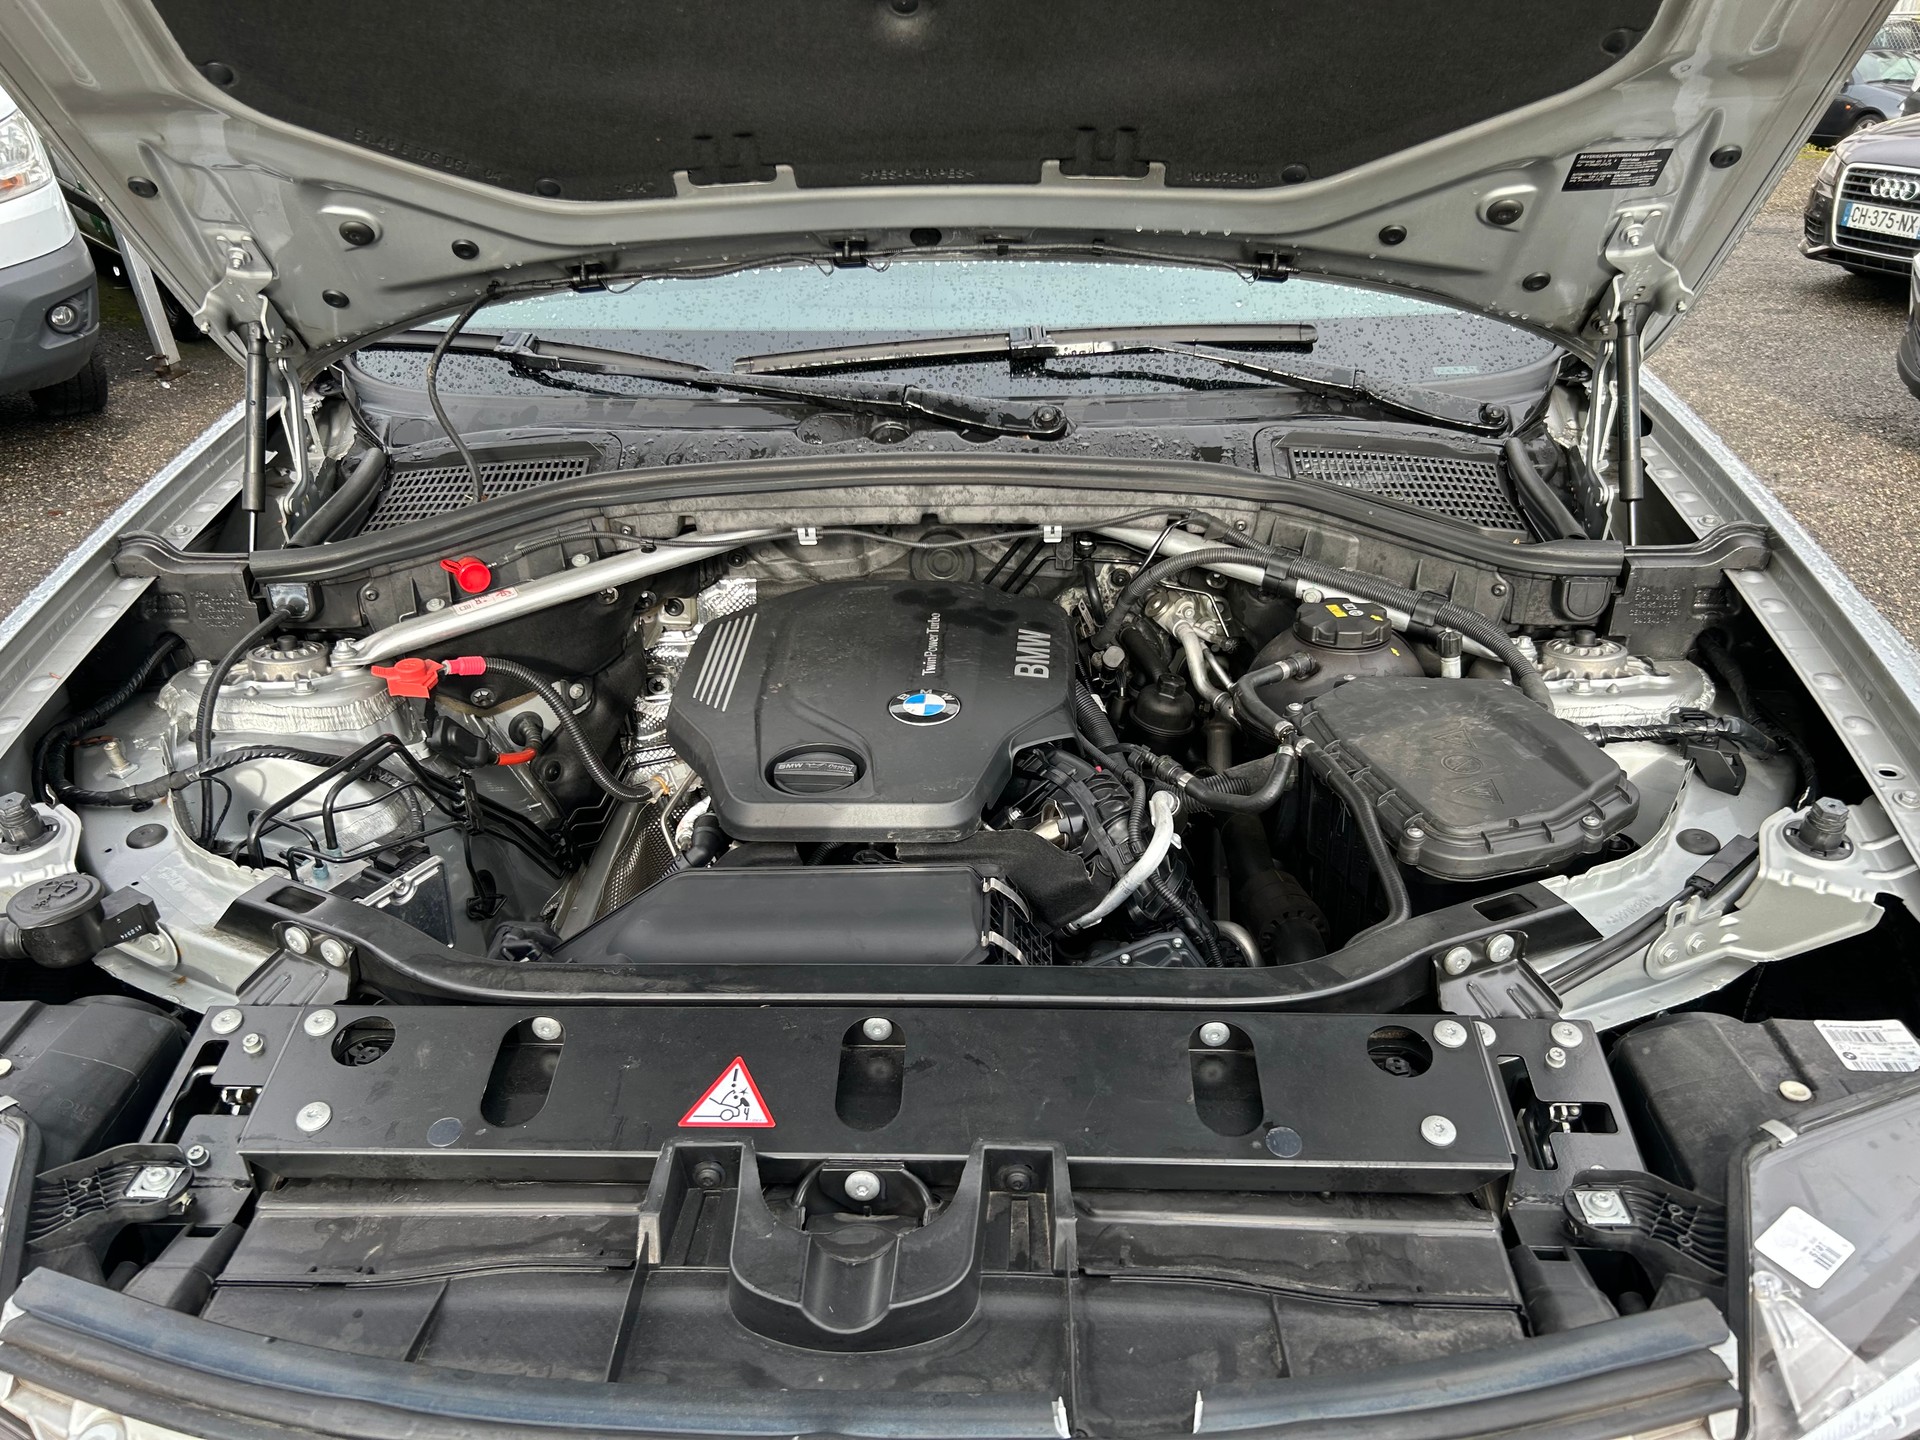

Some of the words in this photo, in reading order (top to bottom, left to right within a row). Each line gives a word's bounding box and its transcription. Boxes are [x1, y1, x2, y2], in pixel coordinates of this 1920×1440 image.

[1851, 206, 1919, 234] CH-375-NX
[926, 612, 941, 634] Turbo
[922, 634, 939, 677] TwinPower
[1014, 628, 1051, 679] BMW
[897, 688, 955, 701] BMW
